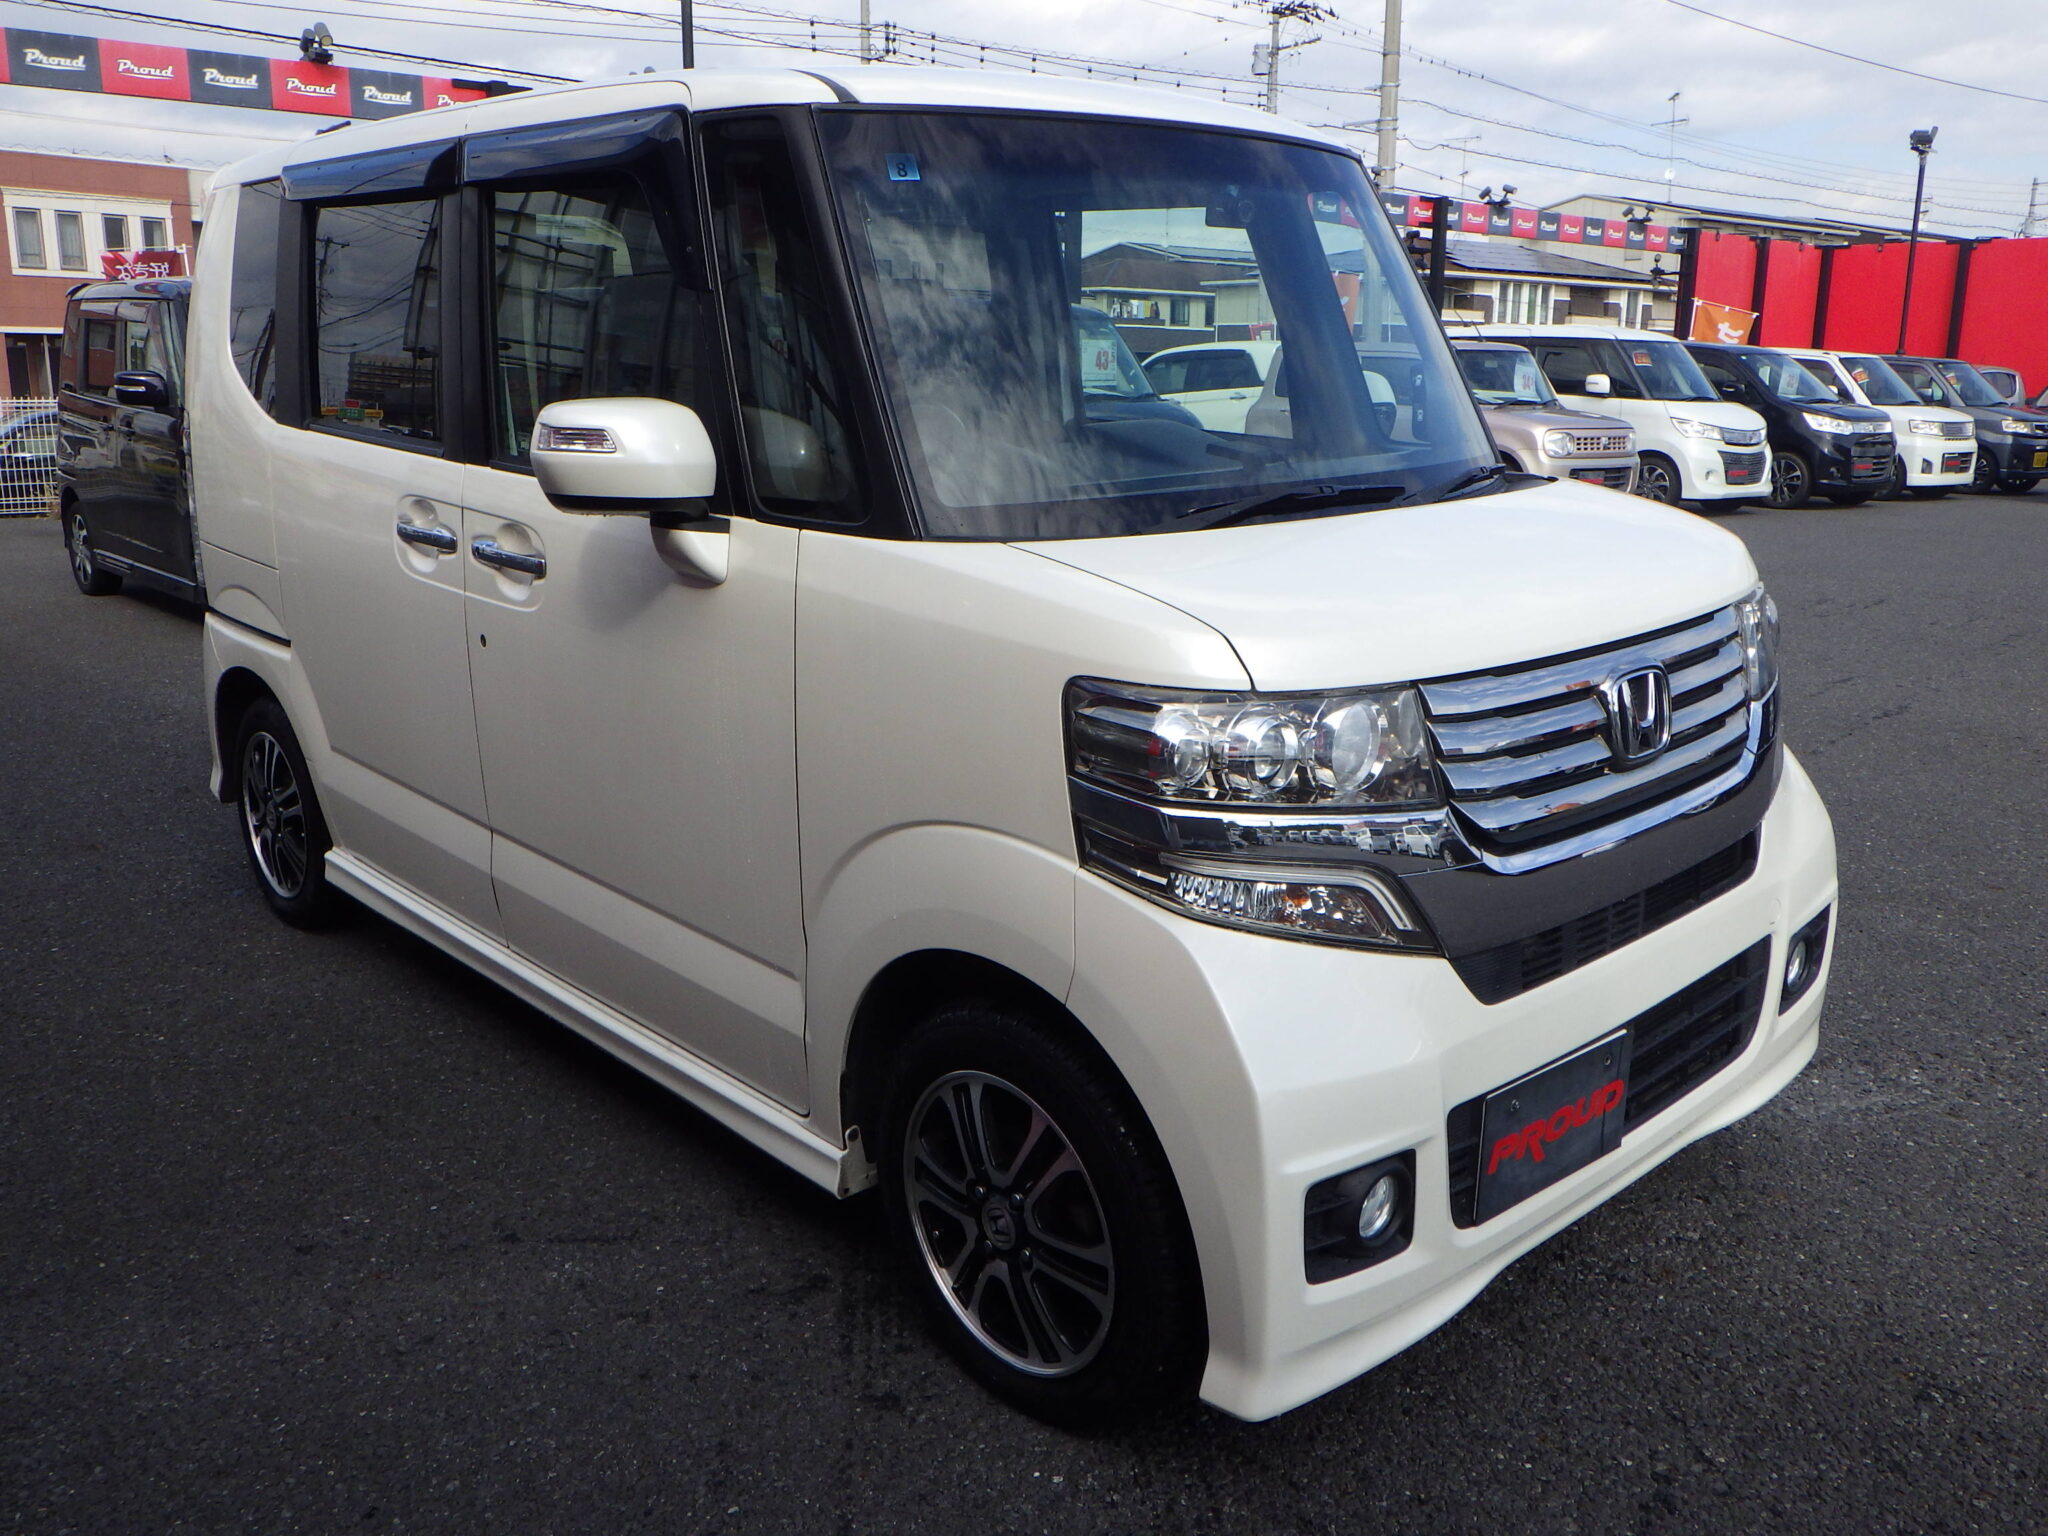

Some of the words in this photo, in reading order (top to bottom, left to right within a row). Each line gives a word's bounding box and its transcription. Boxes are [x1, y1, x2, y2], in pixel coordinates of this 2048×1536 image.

[23, 48, 86, 70] Proud
[117, 59, 175, 79] Proud
[203, 68, 259, 88] Proud
[286, 77, 337, 96] Proud
[362, 85, 413, 105] Proud
[896, 162, 908, 177] 8
[1487, 1079, 1625, 1176] PROUD
